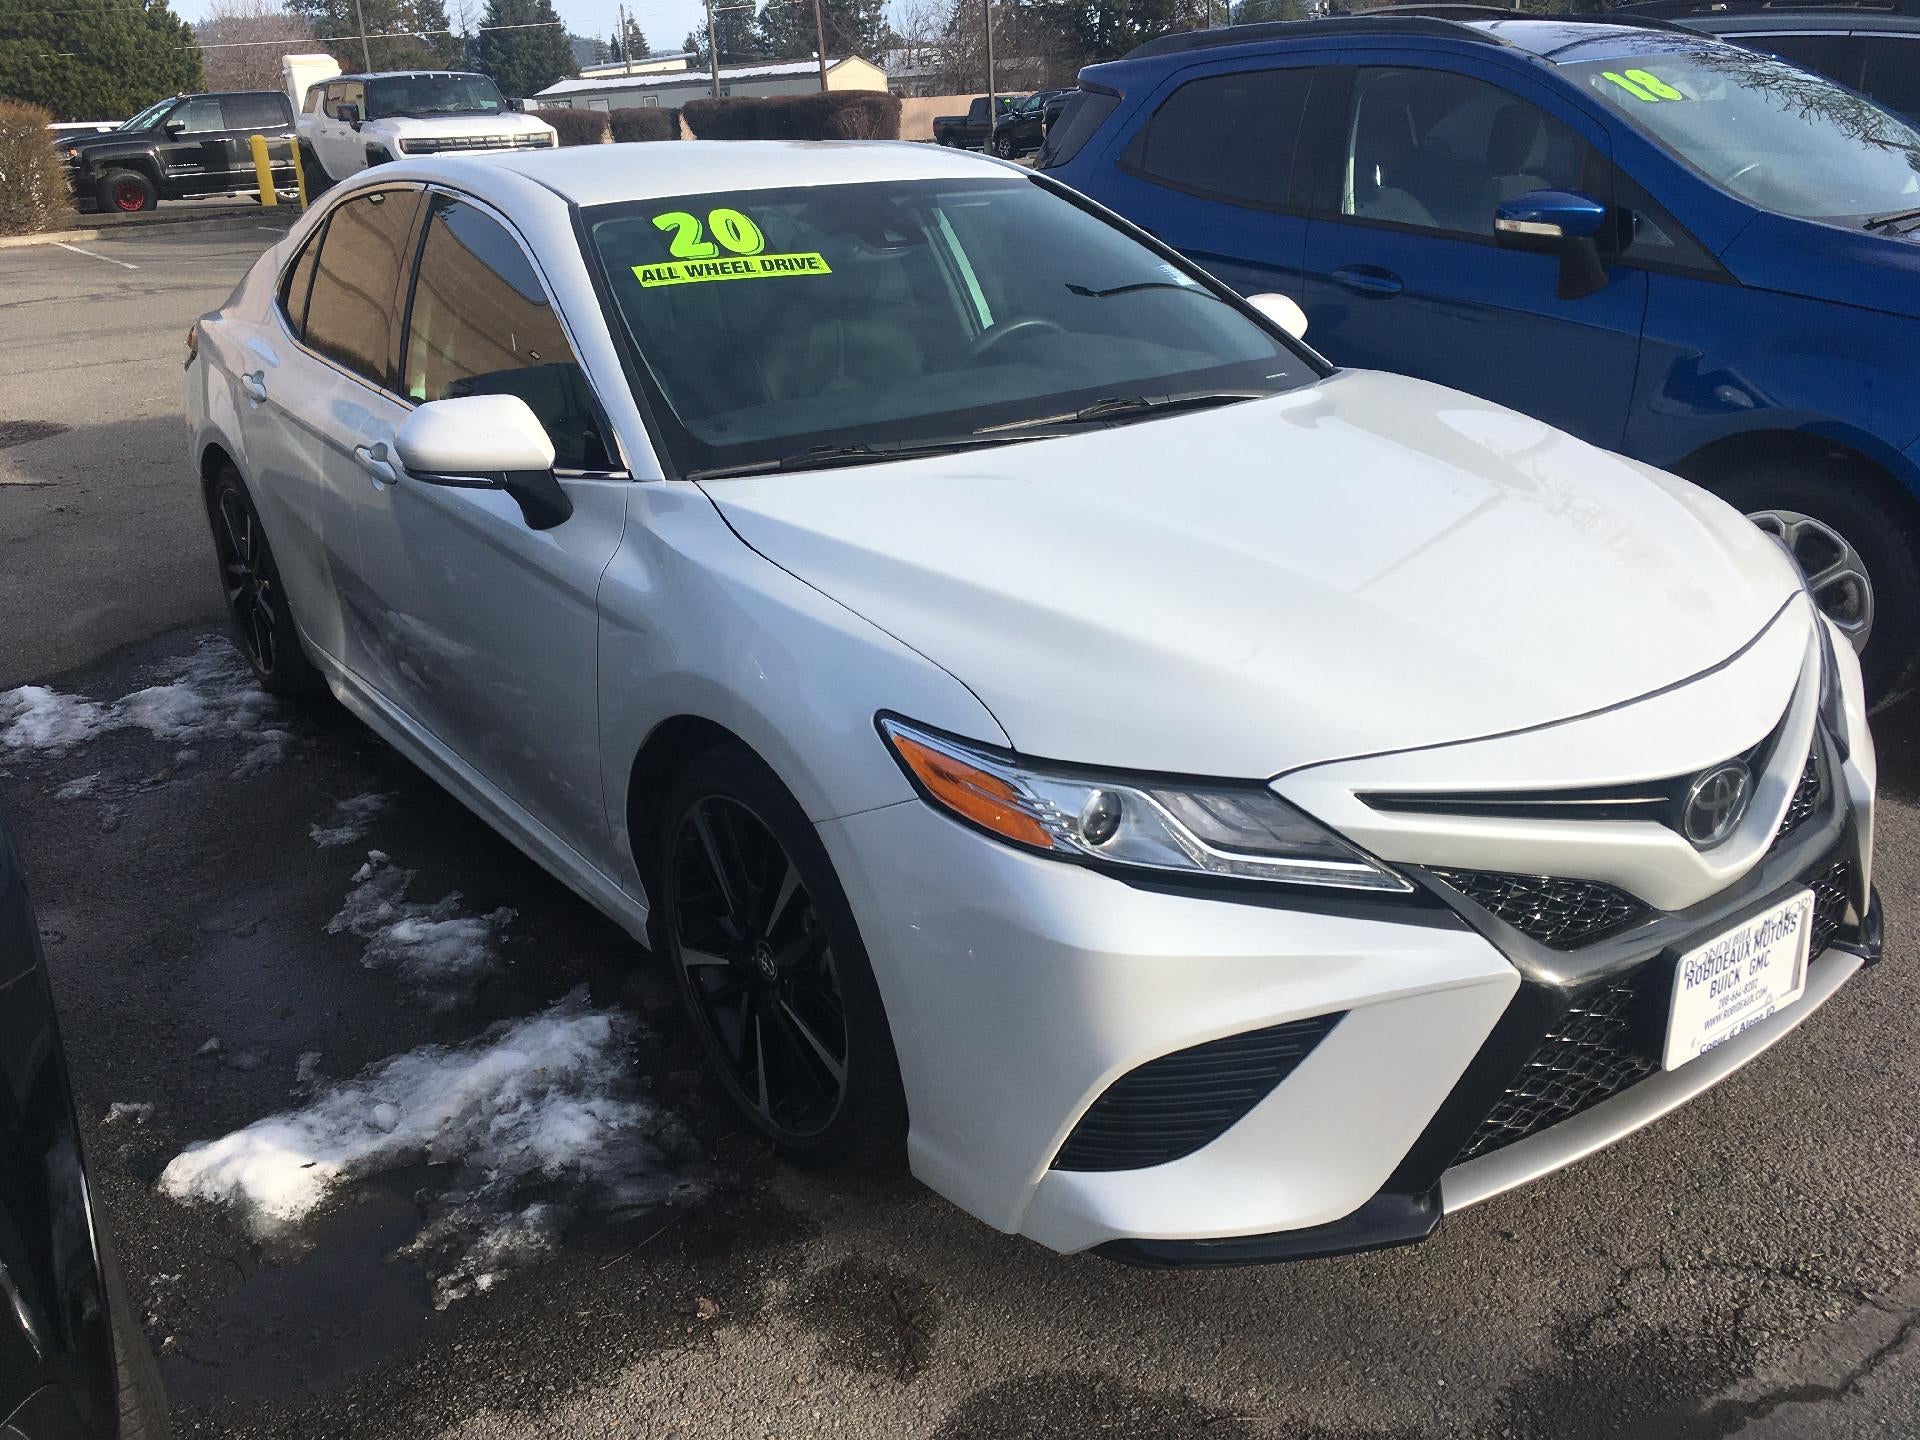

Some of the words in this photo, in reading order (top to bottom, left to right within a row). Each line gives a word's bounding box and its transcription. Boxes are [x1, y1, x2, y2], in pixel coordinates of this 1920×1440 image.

[1602, 69, 1682, 101] 18
[652, 208, 765, 260] 20
[641, 267, 681, 284] ALL
[684, 260, 756, 278] WHEEL
[760, 256, 823, 273] DRIVE
[1687, 941, 1750, 990] ROBIDEAUX
[1754, 913, 1798, 954] MOTORS
[1709, 967, 1741, 999] BUICK
[1749, 949, 1771, 976] GMC
